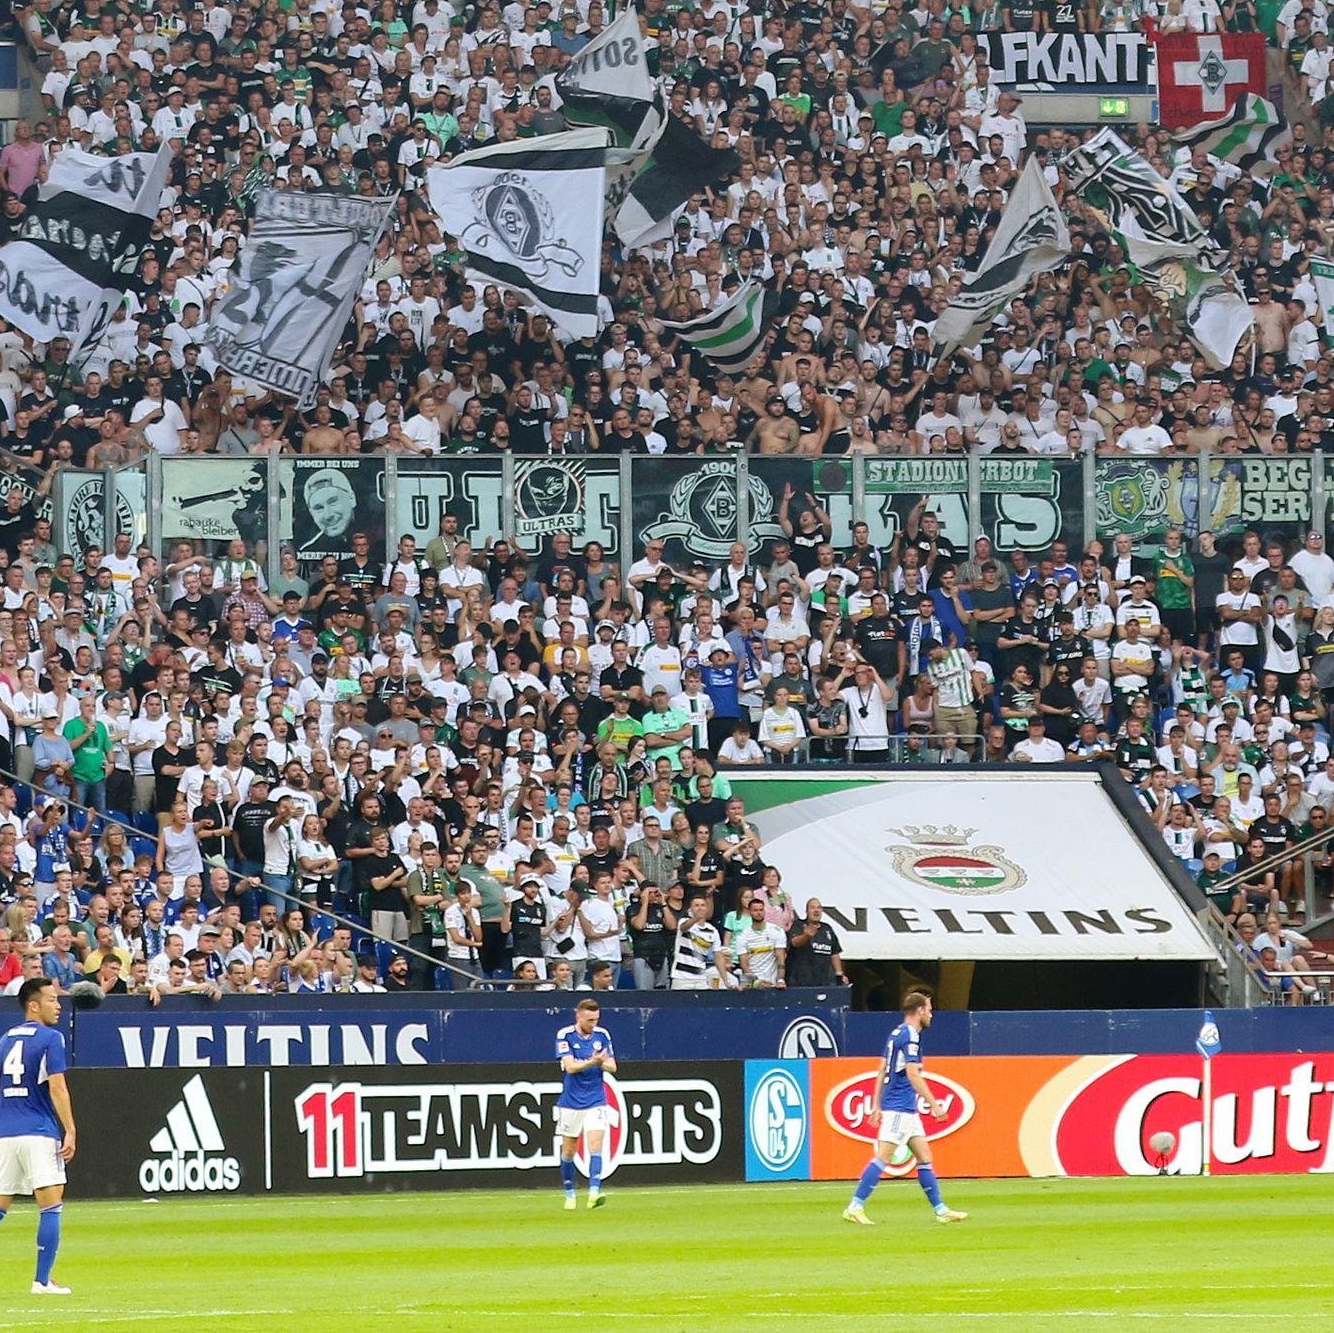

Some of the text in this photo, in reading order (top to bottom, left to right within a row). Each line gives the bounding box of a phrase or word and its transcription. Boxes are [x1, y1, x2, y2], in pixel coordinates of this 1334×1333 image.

[179, 517, 220, 528] rabauke
[522, 515, 576, 533] ULTRAS
[820, 906, 1174, 936] VELTINS
[2, 1038, 25, 1085] 4
[139, 1149, 240, 1193] adidas
